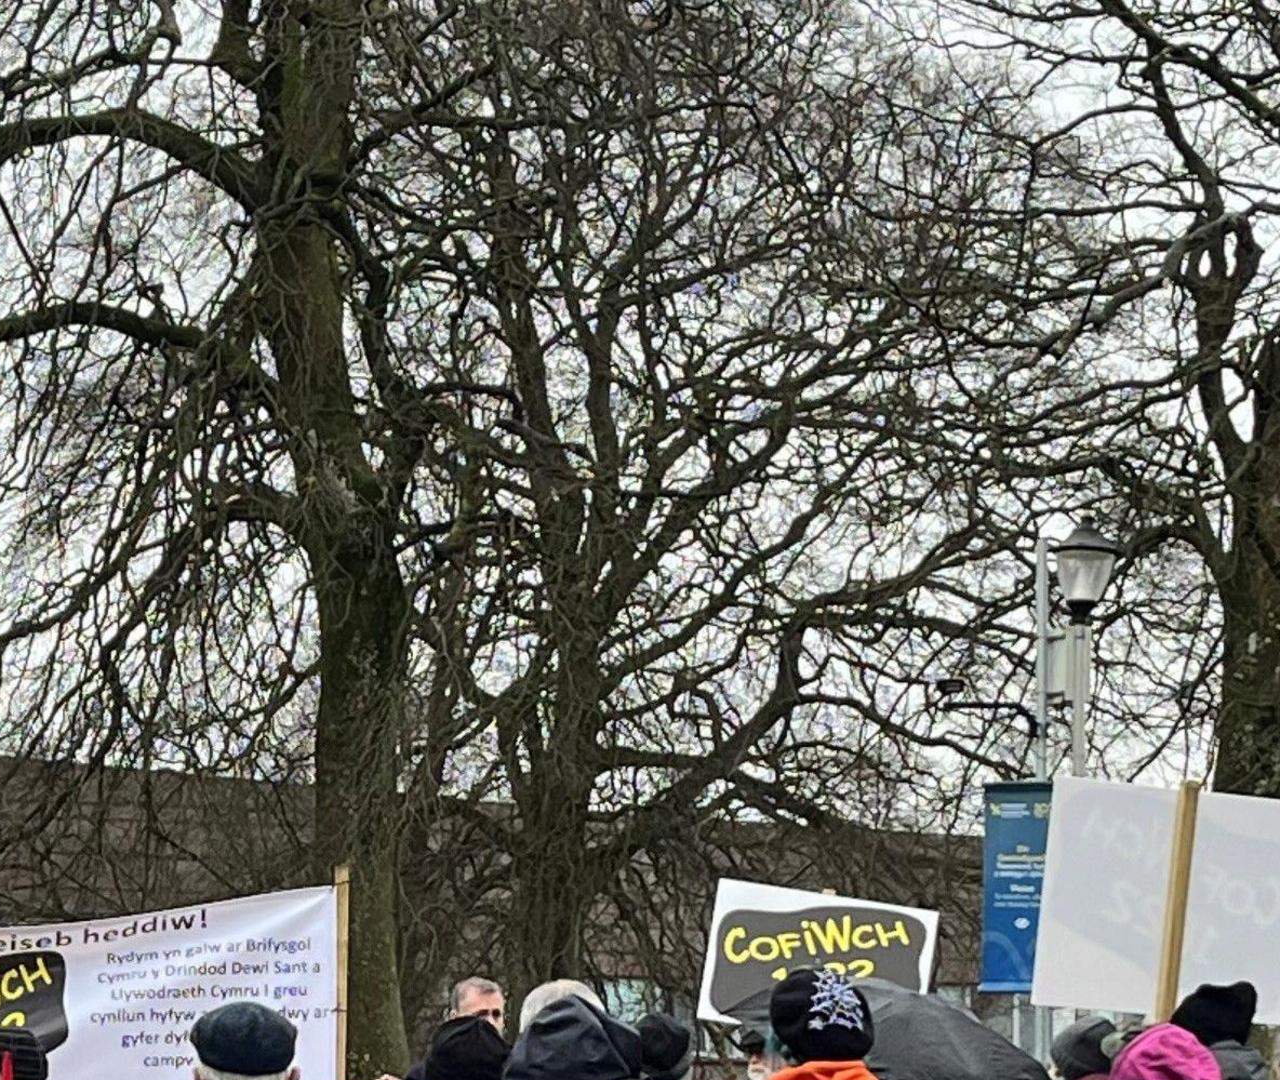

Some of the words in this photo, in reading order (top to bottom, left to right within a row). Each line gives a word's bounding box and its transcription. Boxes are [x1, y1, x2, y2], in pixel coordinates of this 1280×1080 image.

[83, 909, 209, 944] heddiw!
[107, 951, 159, 967] Rydym
[163, 947, 182, 961] yn
[185, 941, 222, 959] galw
[226, 941, 242, 953] ar
[245, 936, 312, 955] Brifysgol
[97, 970, 147, 986] Cymru
[165, 961, 227, 977] Drindod
[273, 959, 308, 975] Sant
[312, 963, 321, 975] a
[110, 984, 206, 1002] Llywodraeth
[210, 984, 260, 1002] Cymru
[272, 985, 308, 1001] greu
[89, 1006, 146, 1025] cynllun
[150, 1005, 196, 1024] hyfyw
[121, 1030, 161, 1048] gyfer
